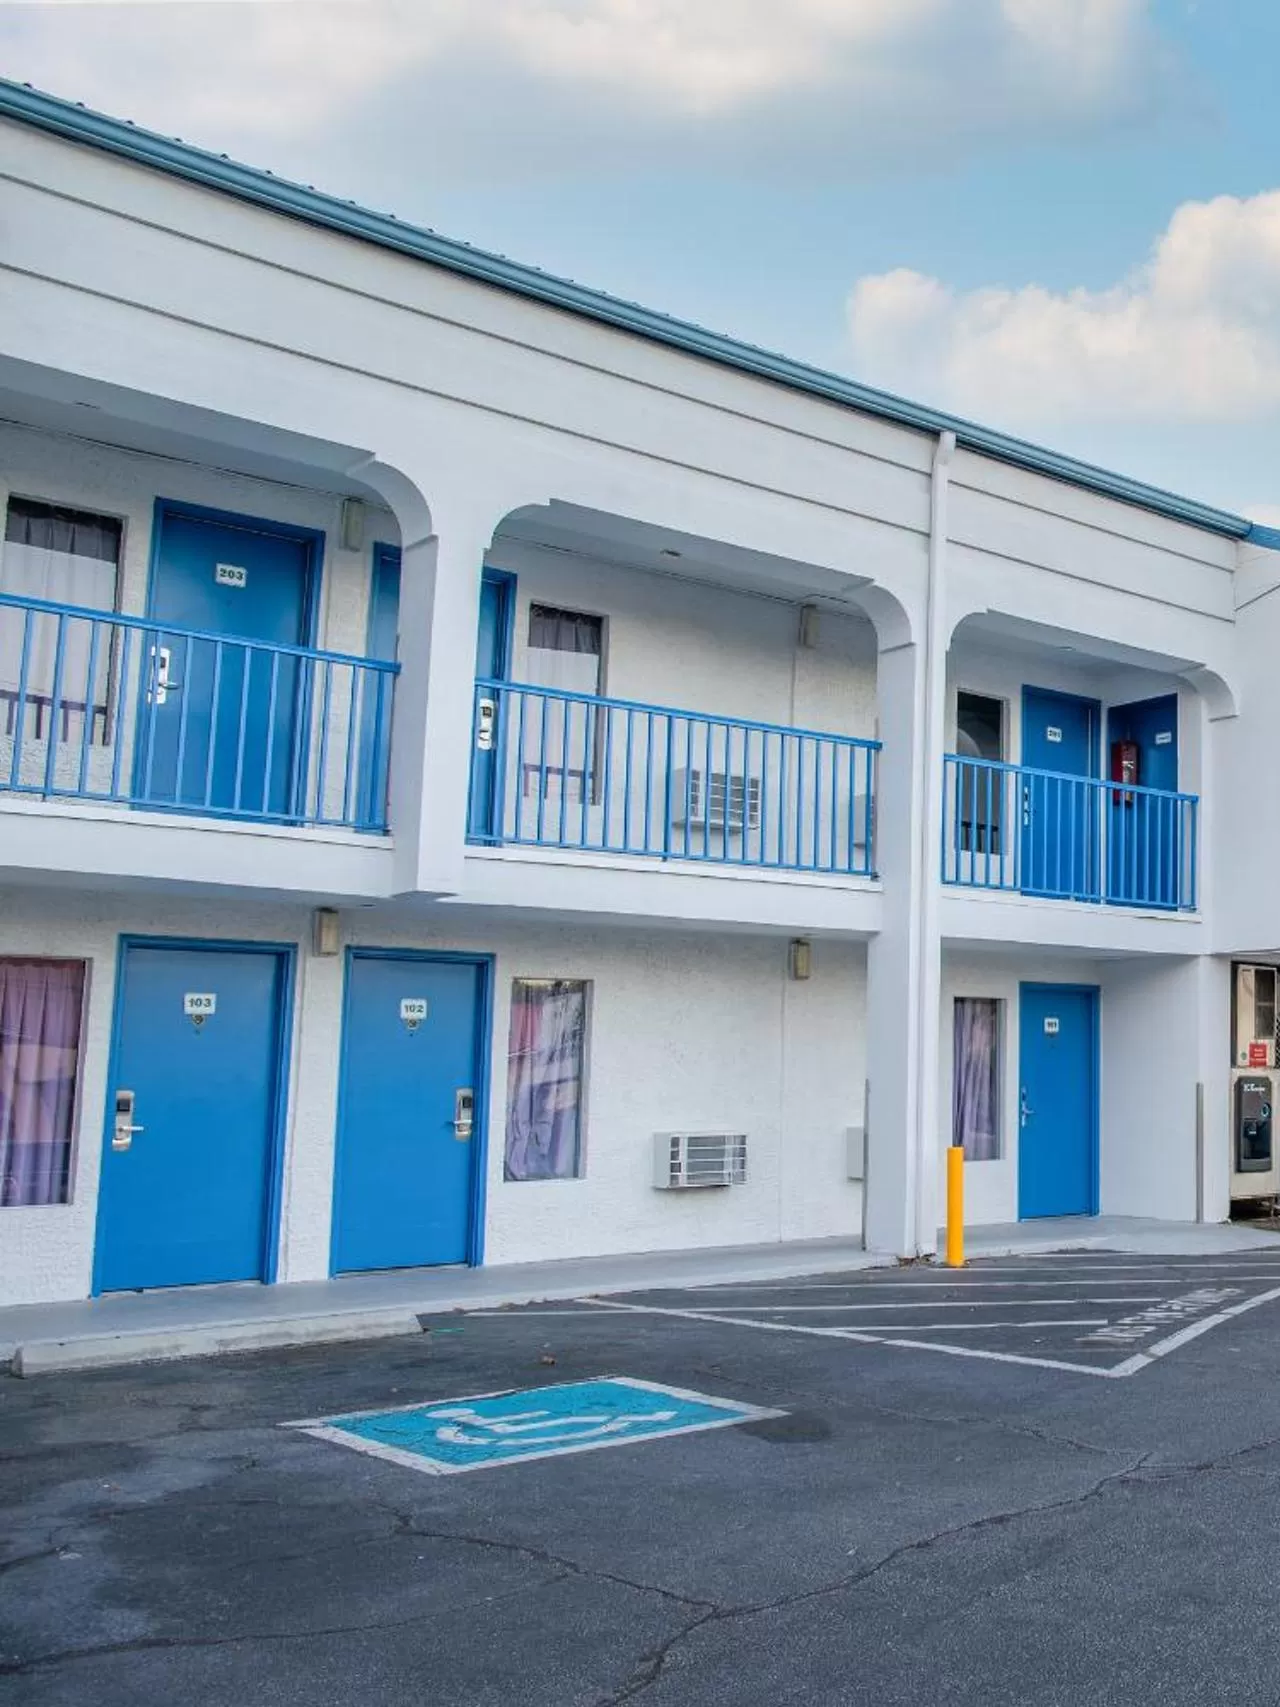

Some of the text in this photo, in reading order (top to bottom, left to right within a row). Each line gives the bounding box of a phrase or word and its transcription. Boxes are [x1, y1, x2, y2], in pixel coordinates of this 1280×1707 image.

[219, 567, 243, 581] 203
[189, 997, 211, 1008] 103
[404, 1004, 424, 1013] 102
